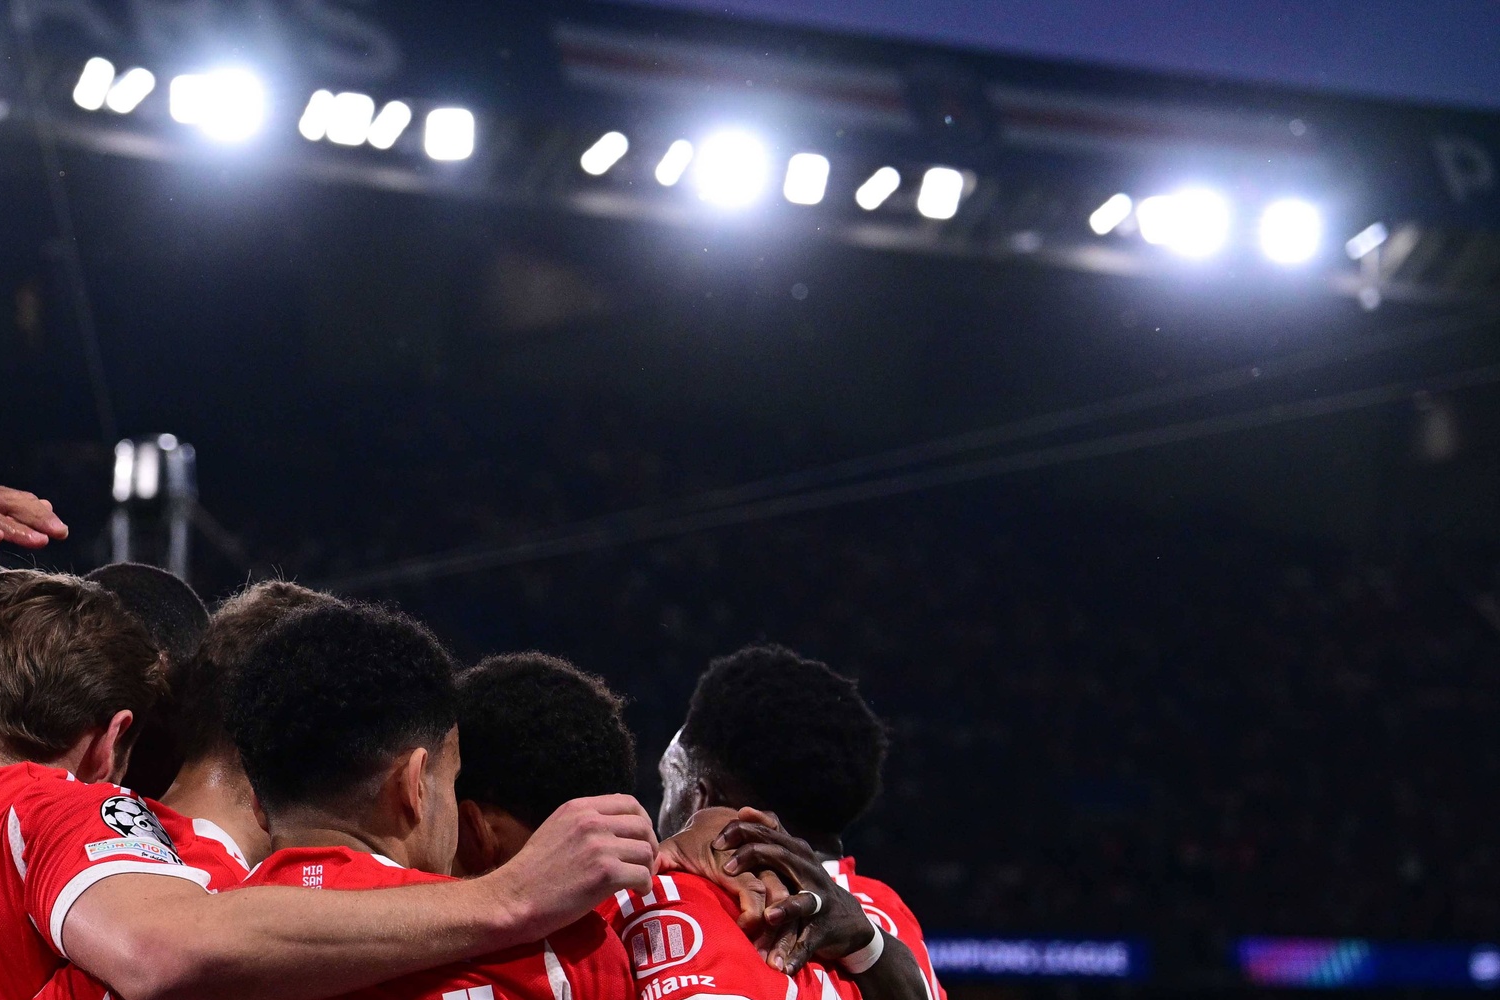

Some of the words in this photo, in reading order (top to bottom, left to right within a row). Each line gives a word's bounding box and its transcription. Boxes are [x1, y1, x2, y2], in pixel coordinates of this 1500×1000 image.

[89, 843, 168, 858] FOUNDATION
[303, 865, 323, 876] MIA
[302, 875, 323, 887] SAN
